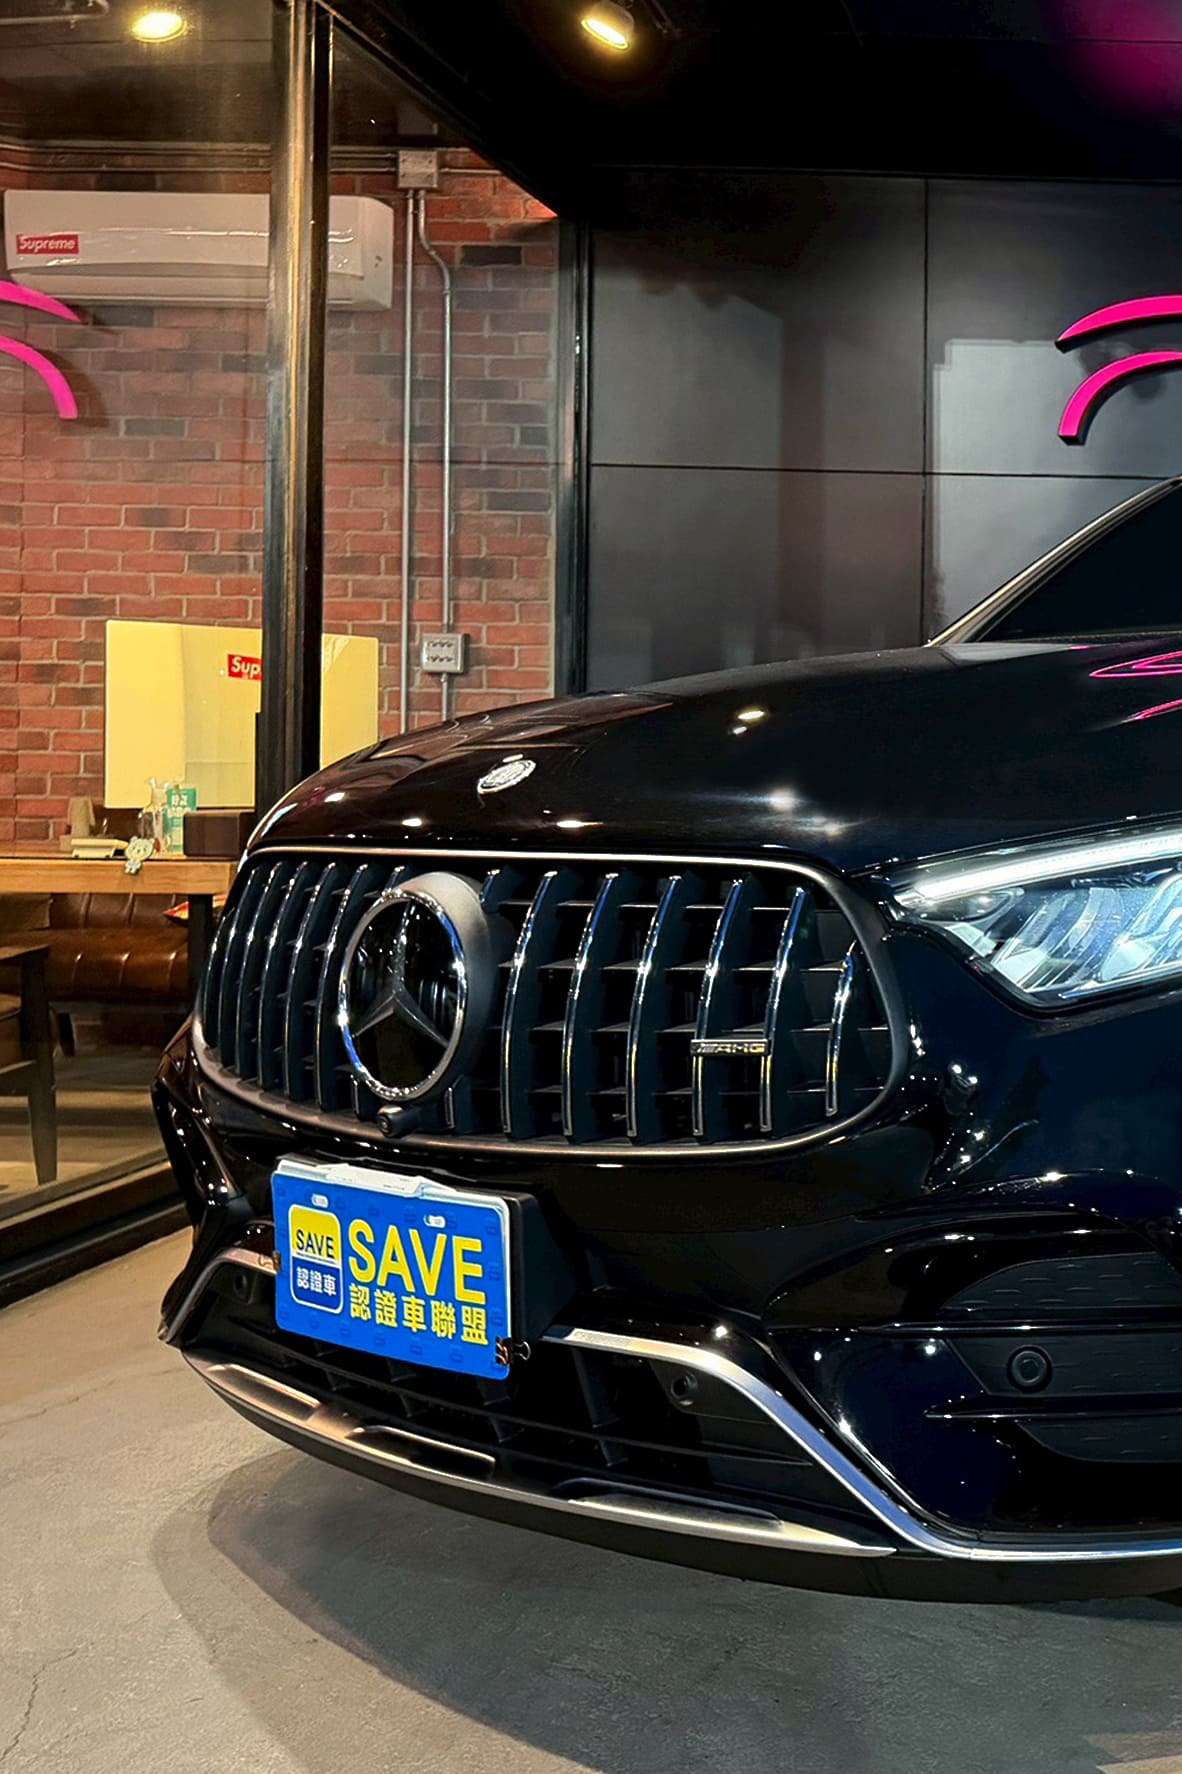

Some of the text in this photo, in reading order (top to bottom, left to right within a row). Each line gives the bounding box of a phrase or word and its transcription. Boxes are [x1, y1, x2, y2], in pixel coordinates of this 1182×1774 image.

[19, 235, 76, 253] Supreme
[295, 1229, 335, 1259] SAVE
[348, 1218, 486, 1305] SAVE
[348, 1282, 489, 1346] 認證車聯盟
